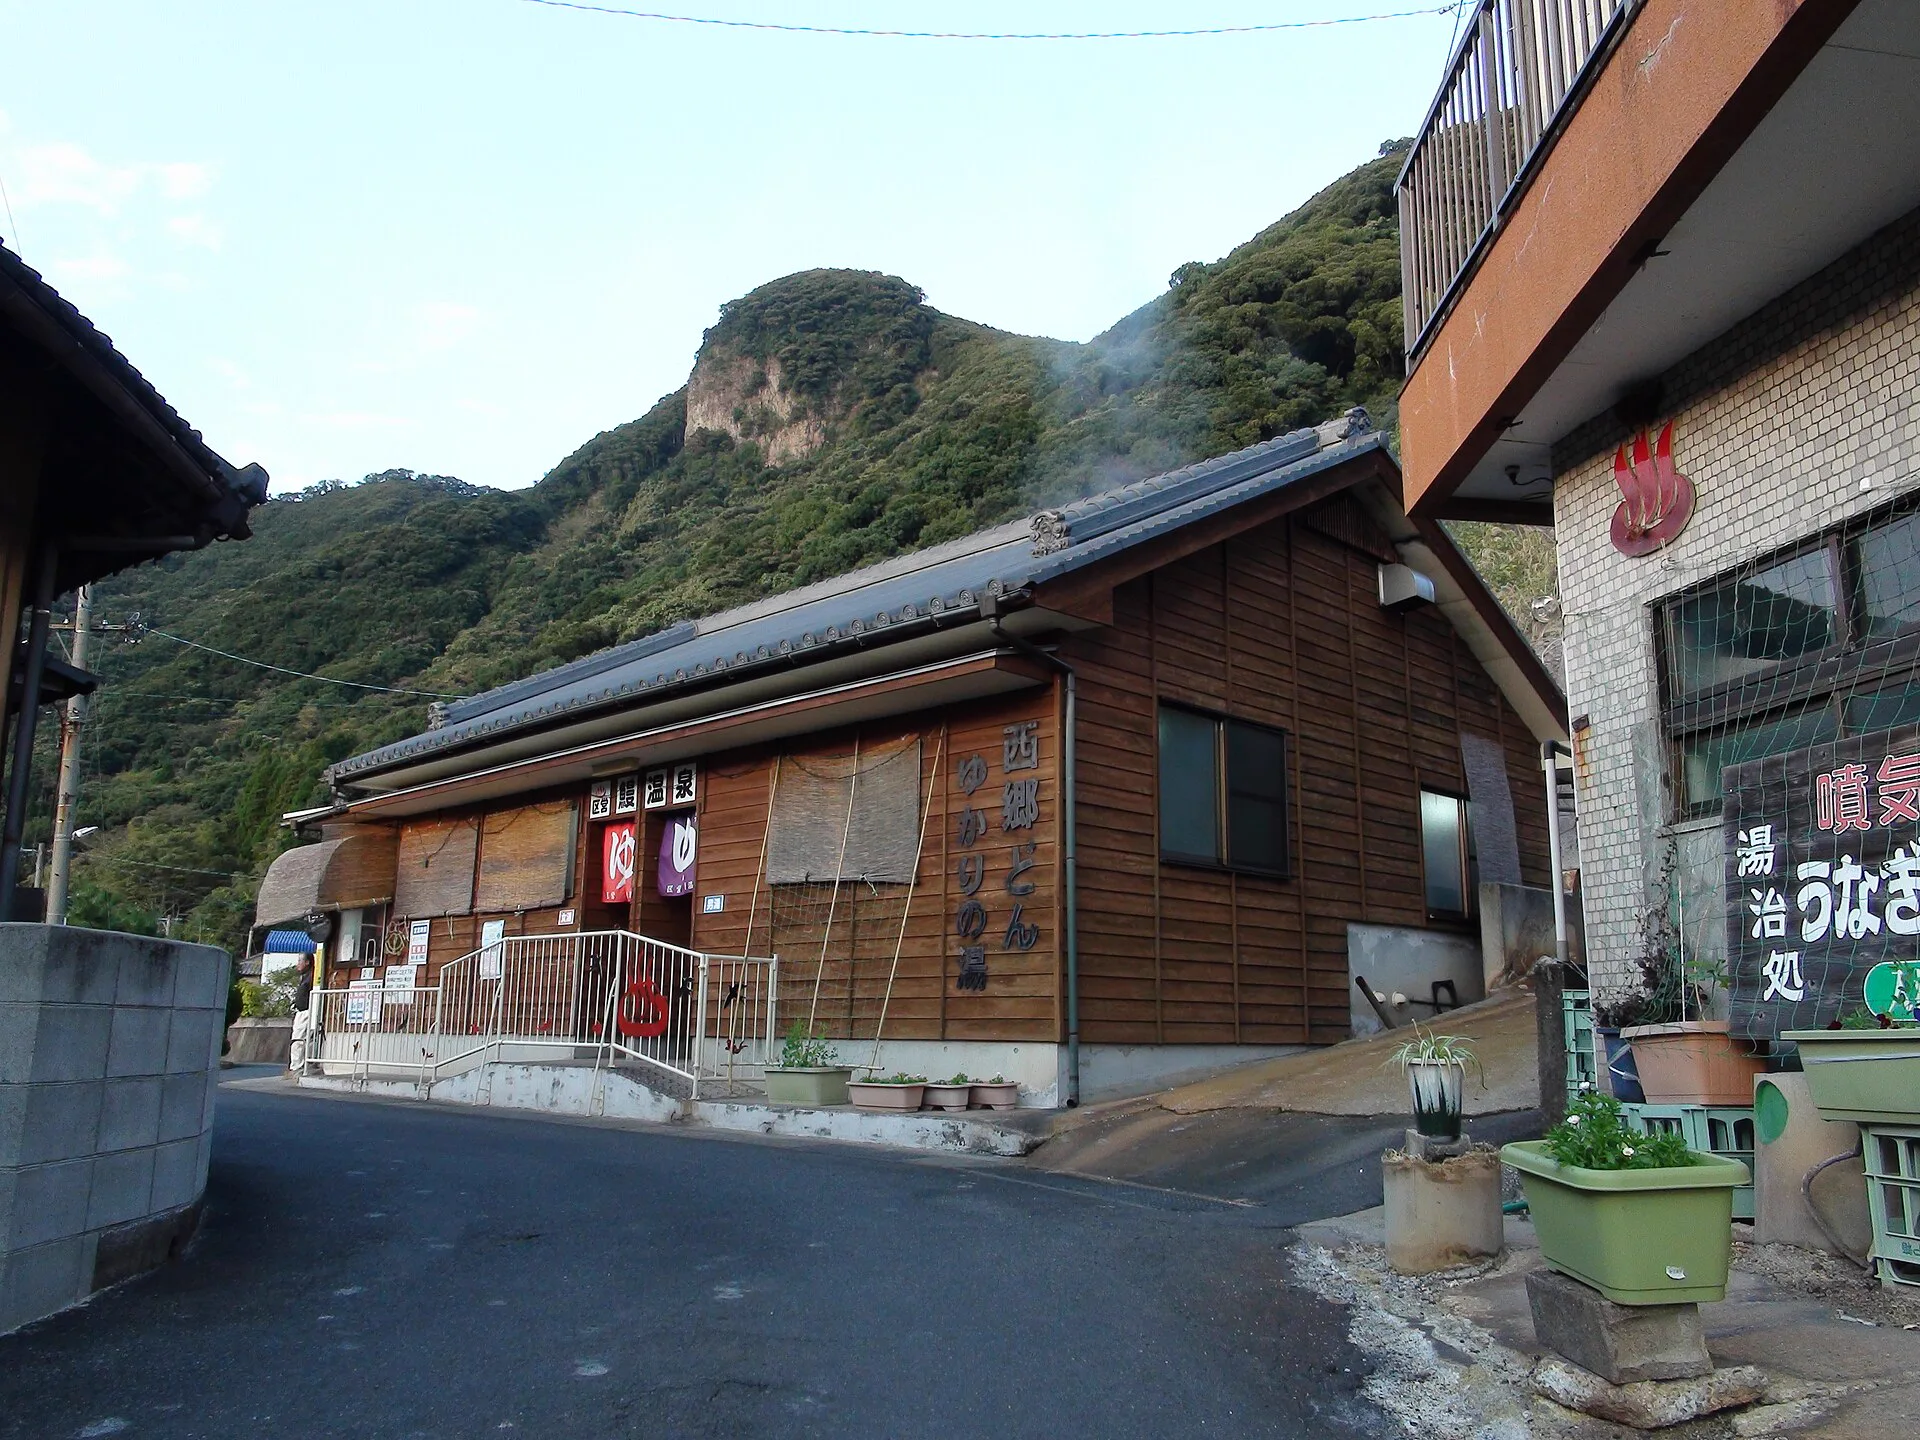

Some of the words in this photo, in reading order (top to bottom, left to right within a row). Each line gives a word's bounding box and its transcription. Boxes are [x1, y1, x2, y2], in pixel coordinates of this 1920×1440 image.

[592, 798, 609, 815] 区営
[1003, 720, 1040, 950] 西郷どん
[1815, 754, 1920, 835] 噴気
[609, 828, 636, 890] ゆ
[956, 753, 989, 991] ゆかりの湯
[1796, 837, 1920, 943] うなぎ
[1735, 824, 1804, 1002] 湯治処
